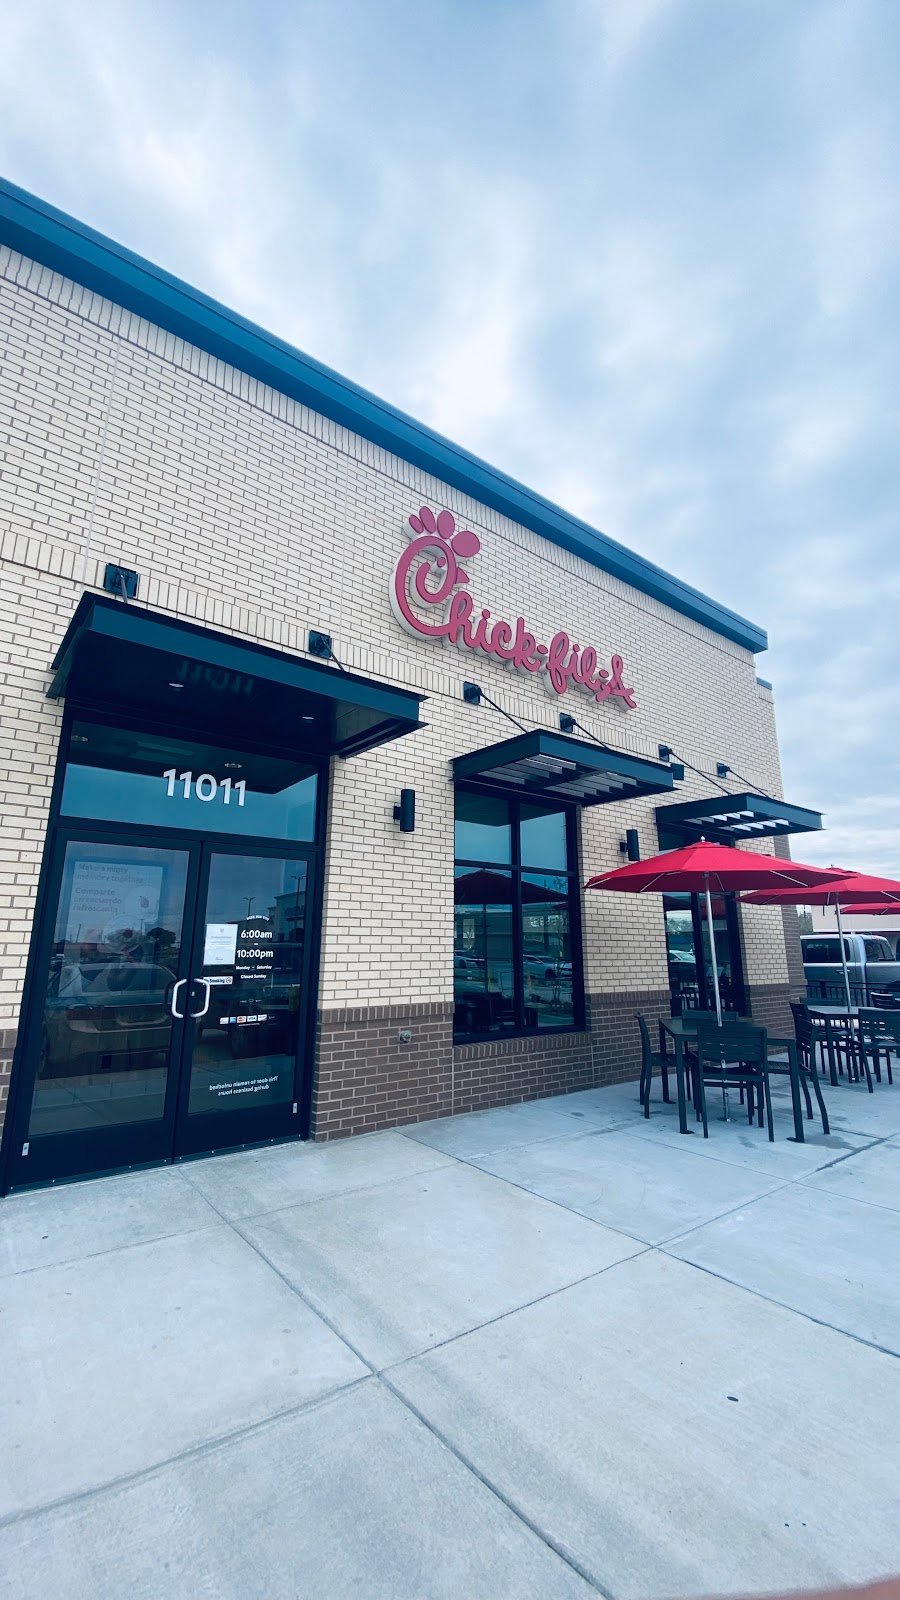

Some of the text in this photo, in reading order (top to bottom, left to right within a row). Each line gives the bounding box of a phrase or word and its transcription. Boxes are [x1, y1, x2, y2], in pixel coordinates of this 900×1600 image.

[390, 506, 638, 711] Chick-fil-A
[163, 768, 247, 807] 11011
[79, 863, 98, 872] Make
[240, 930, 272, 939] 6:00am
[236, 950, 274, 959] 10:00pm
